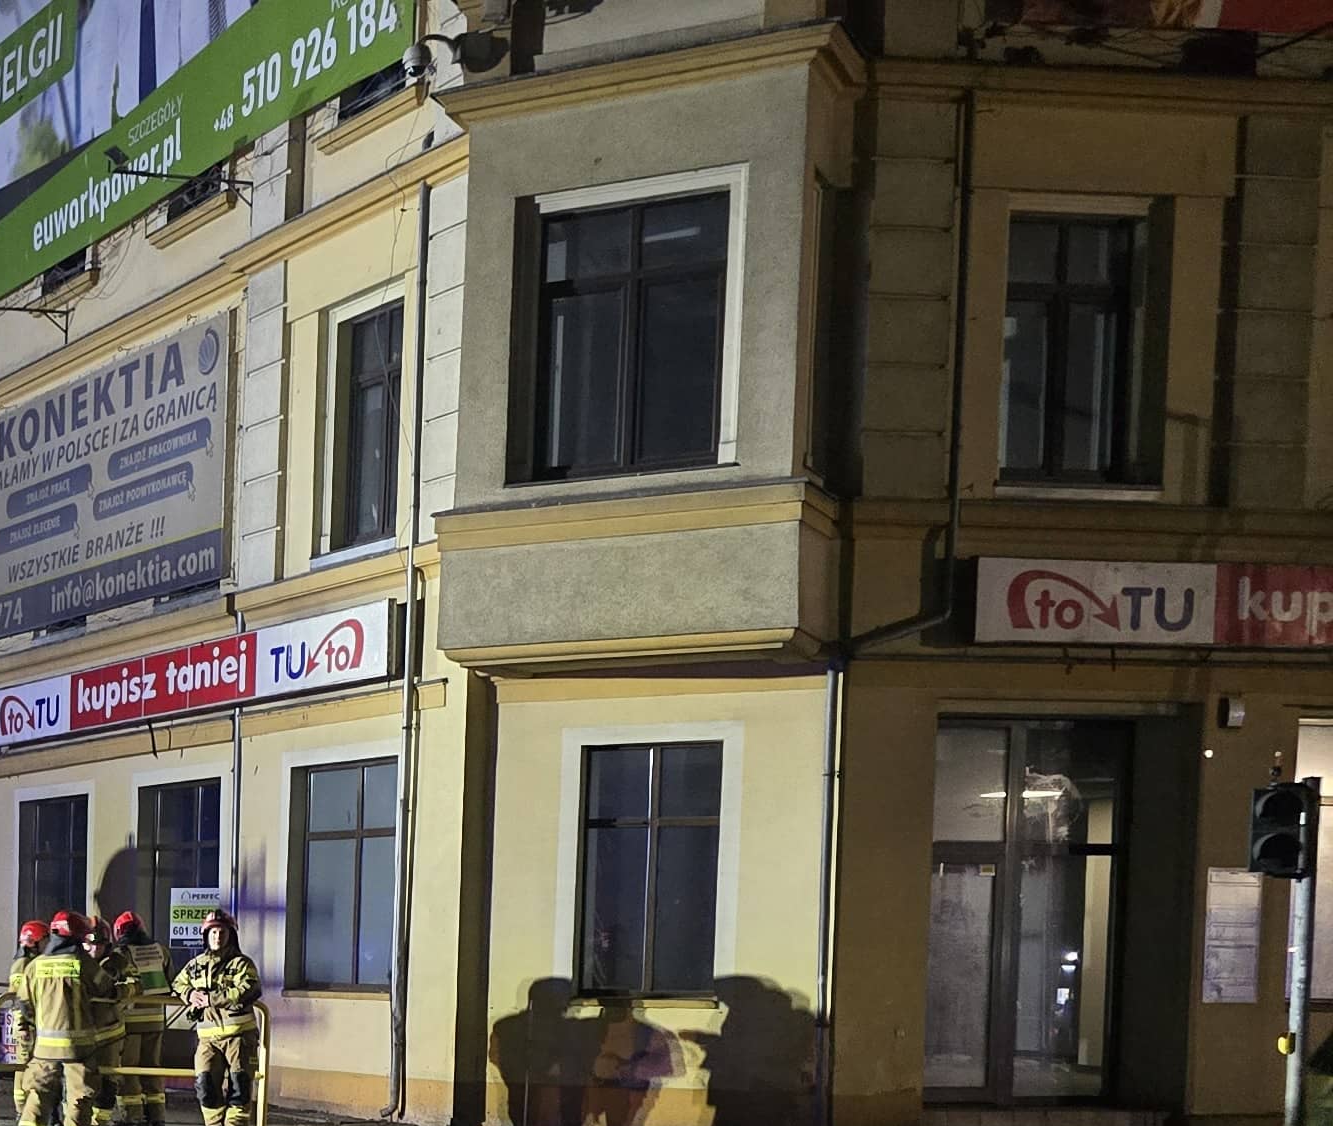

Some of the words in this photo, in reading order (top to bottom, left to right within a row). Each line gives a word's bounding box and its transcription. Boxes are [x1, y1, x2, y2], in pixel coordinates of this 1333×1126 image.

[213, 103, 234, 132] +48
[241, 52, 282, 117] 510
[291, 16, 337, 88] 926
[347, 0, 398, 56] 184
[128, 95, 184, 147] SZCZEGÓŁY
[33, 117, 182, 251] euworkpower.pl
[42, 454, 54, 474] W
[57, 425, 110, 468] POLSCE
[120, 414, 139, 442] ZA
[144, 382, 217, 431] GRANICĄ
[8, 543, 80, 584] WSZYSTKIE
[85, 521, 145, 560] BRANŻE
[50, 546, 216, 614] info@konektia.com
[1034, 588, 1085, 630] to
[1122, 586, 1196, 632] TU
[7, 708, 24, 735] to
[35, 694, 60, 730] TU
[76, 667, 157, 718] kupisz
[166, 640, 247, 695] taniej
[269, 641, 307, 684] TU
[324, 640, 351, 673] to
[172, 926, 189, 936] 601
